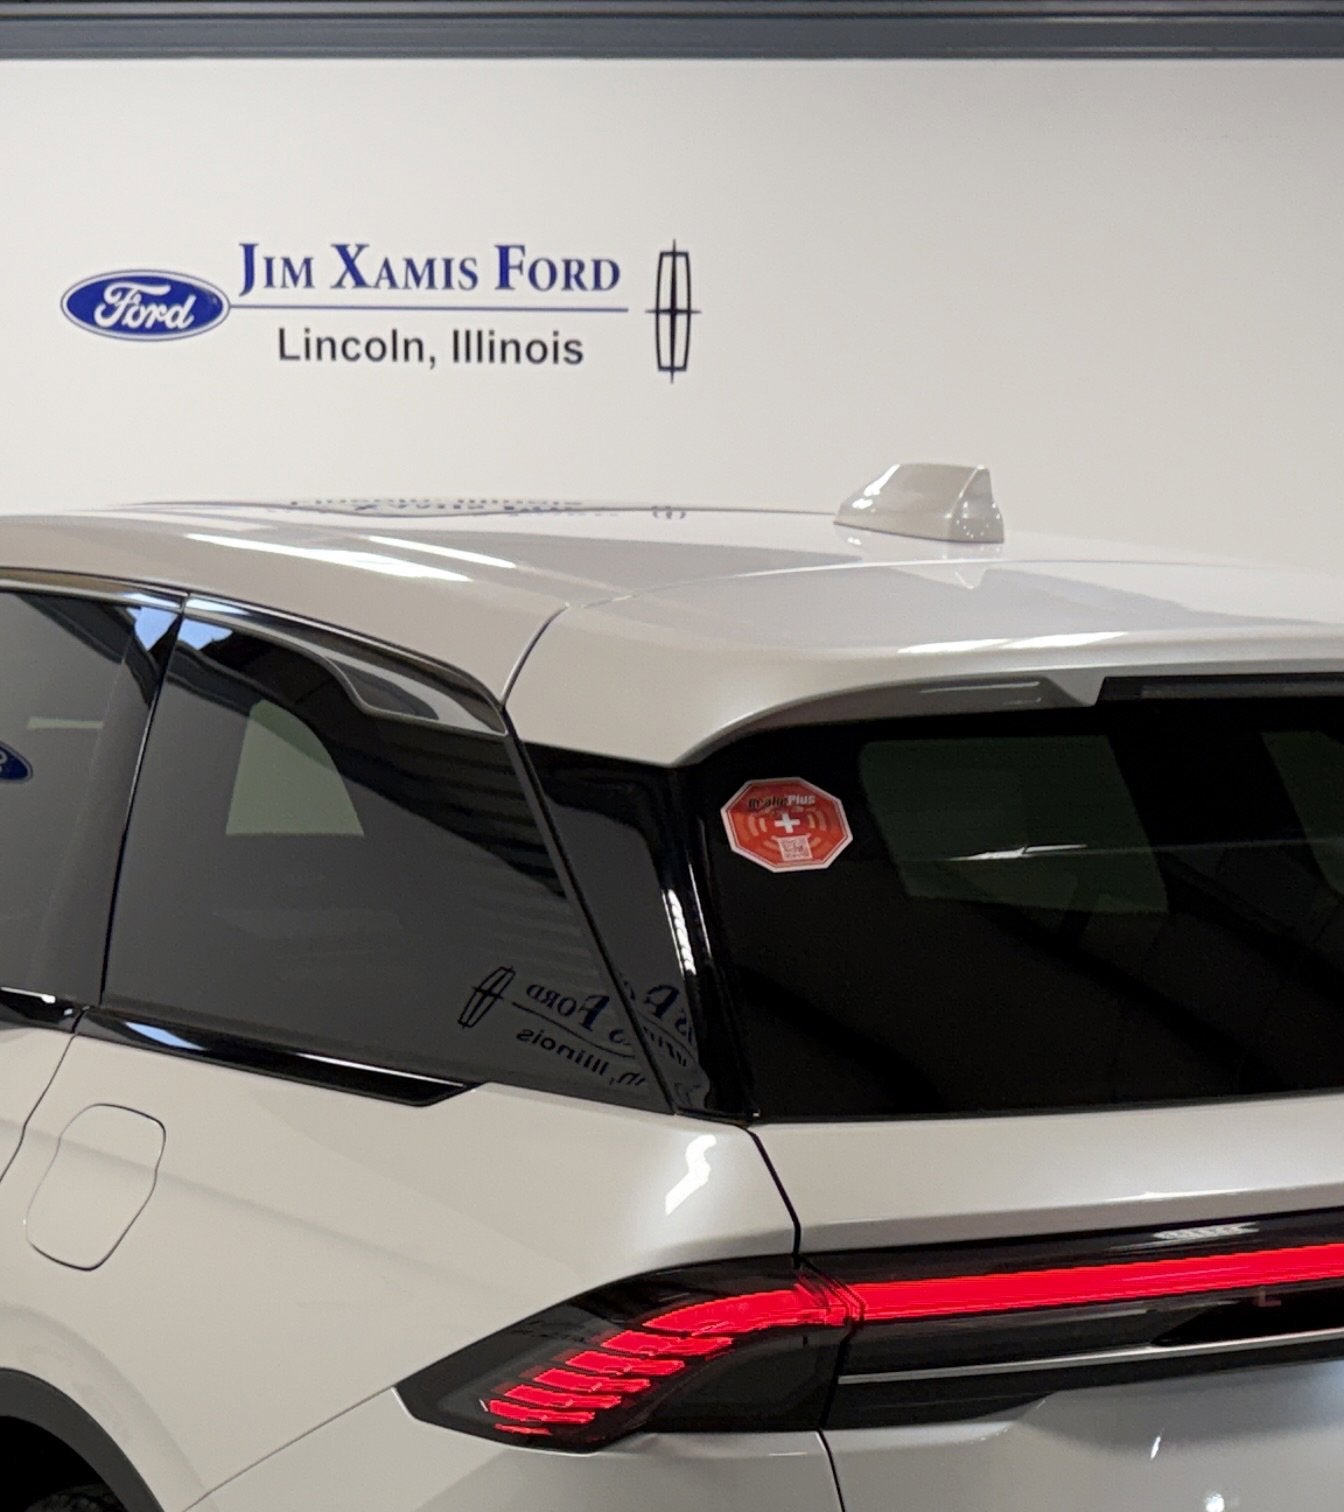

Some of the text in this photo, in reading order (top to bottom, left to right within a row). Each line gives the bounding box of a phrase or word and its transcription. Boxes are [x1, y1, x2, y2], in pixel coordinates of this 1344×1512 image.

[238, 242, 622, 296] JIM XAMIS FORD
[93, 280, 196, 331] Ford
[277, 327, 585, 369] Lincoln, Illinois
